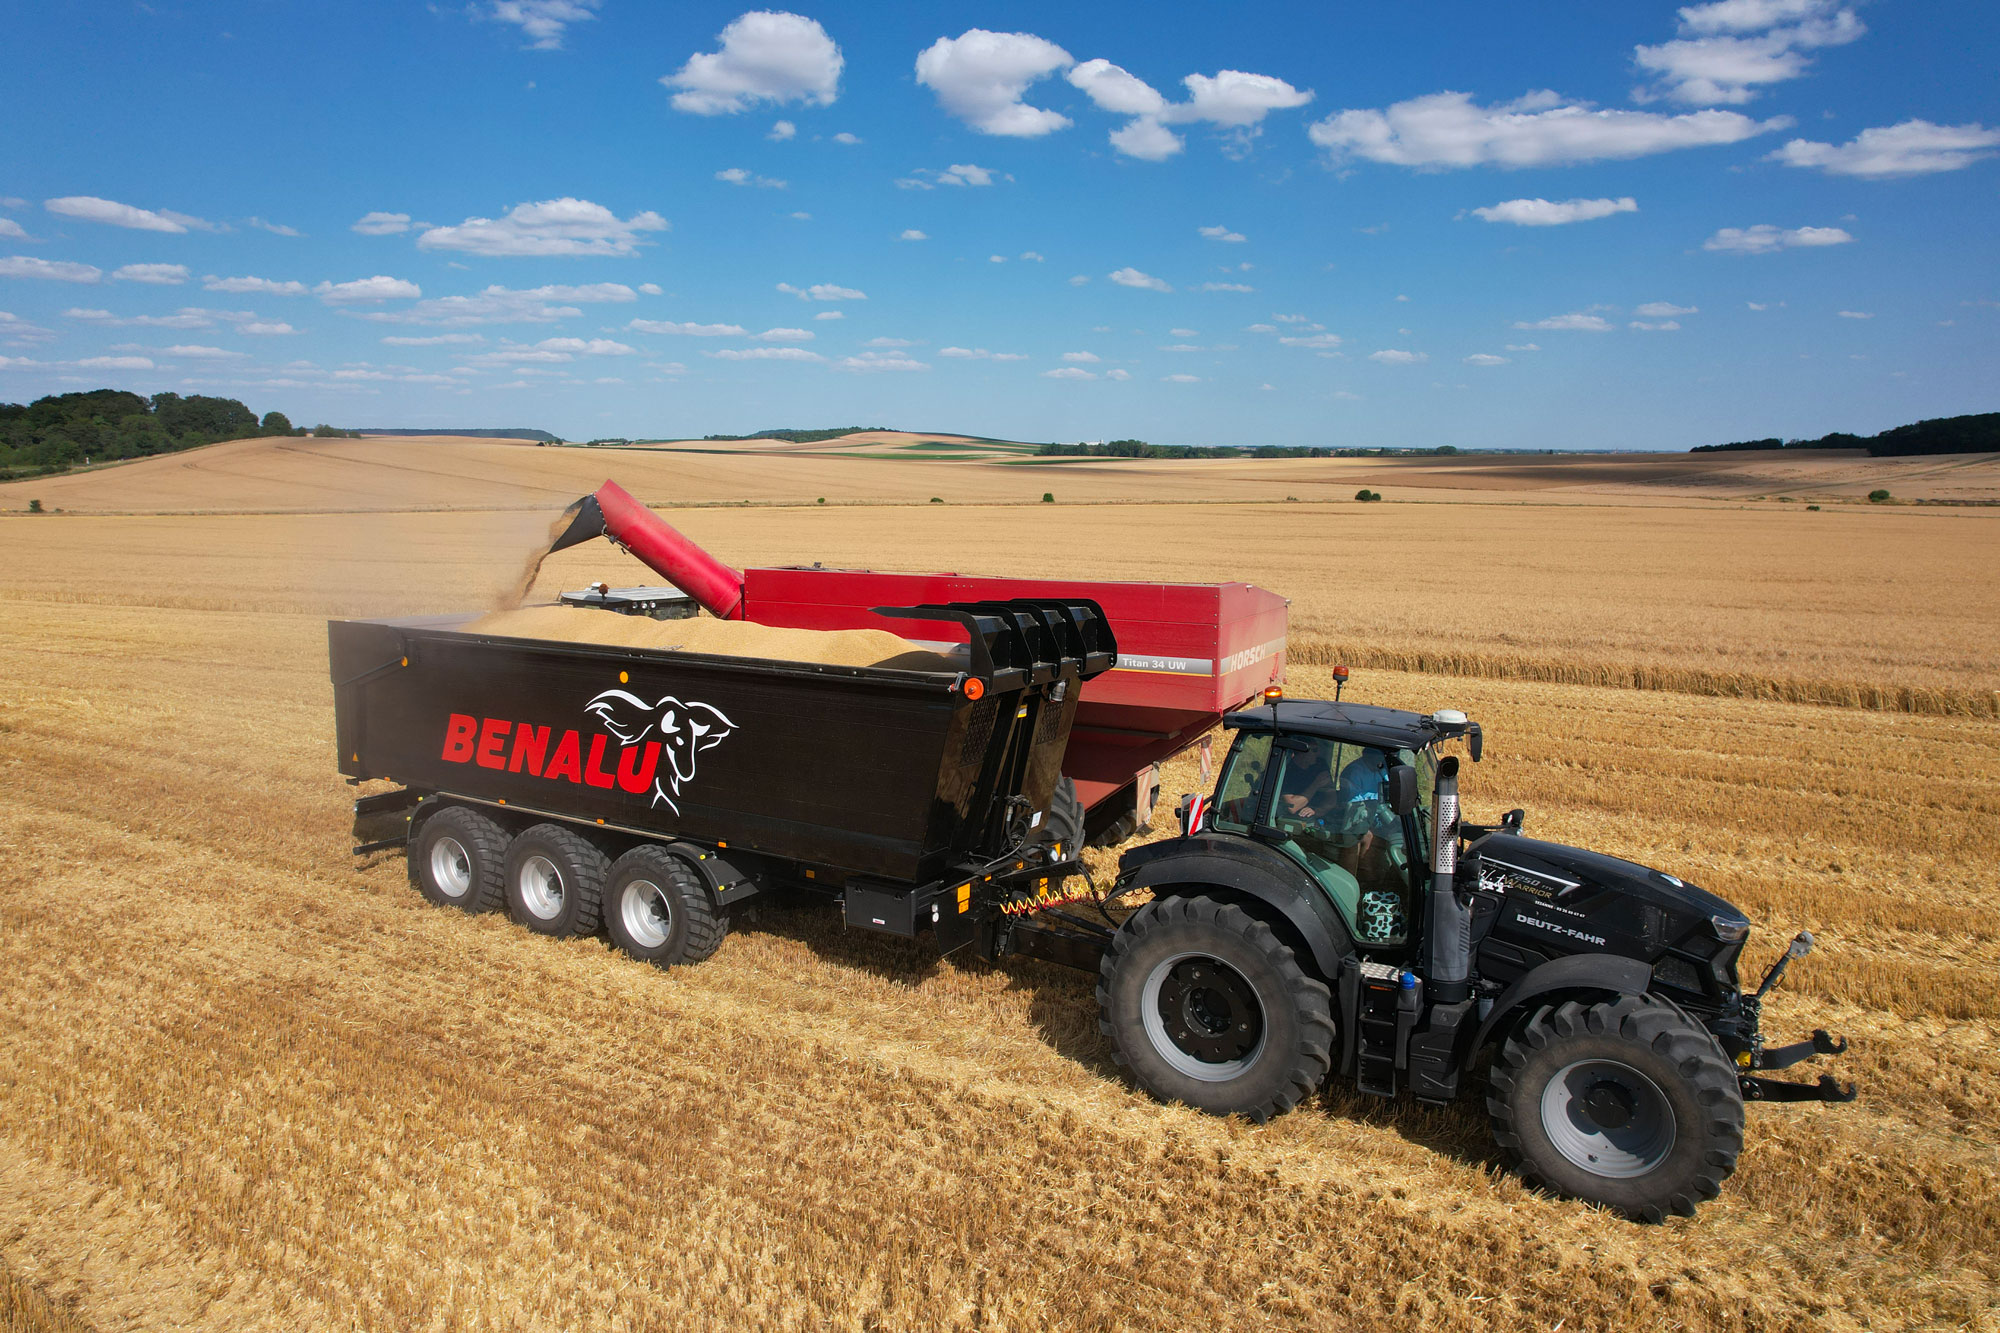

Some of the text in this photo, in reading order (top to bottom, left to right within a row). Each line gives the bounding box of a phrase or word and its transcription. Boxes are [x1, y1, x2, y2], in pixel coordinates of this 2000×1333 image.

[1123, 657, 1187, 671] Titan 34 UW
[1230, 644, 1266, 673] HORSCH
[441, 712, 662, 794] BENALU
[1508, 872, 1541, 886] 7250
[1516, 914, 1606, 946] DEUTZ-FAHR
